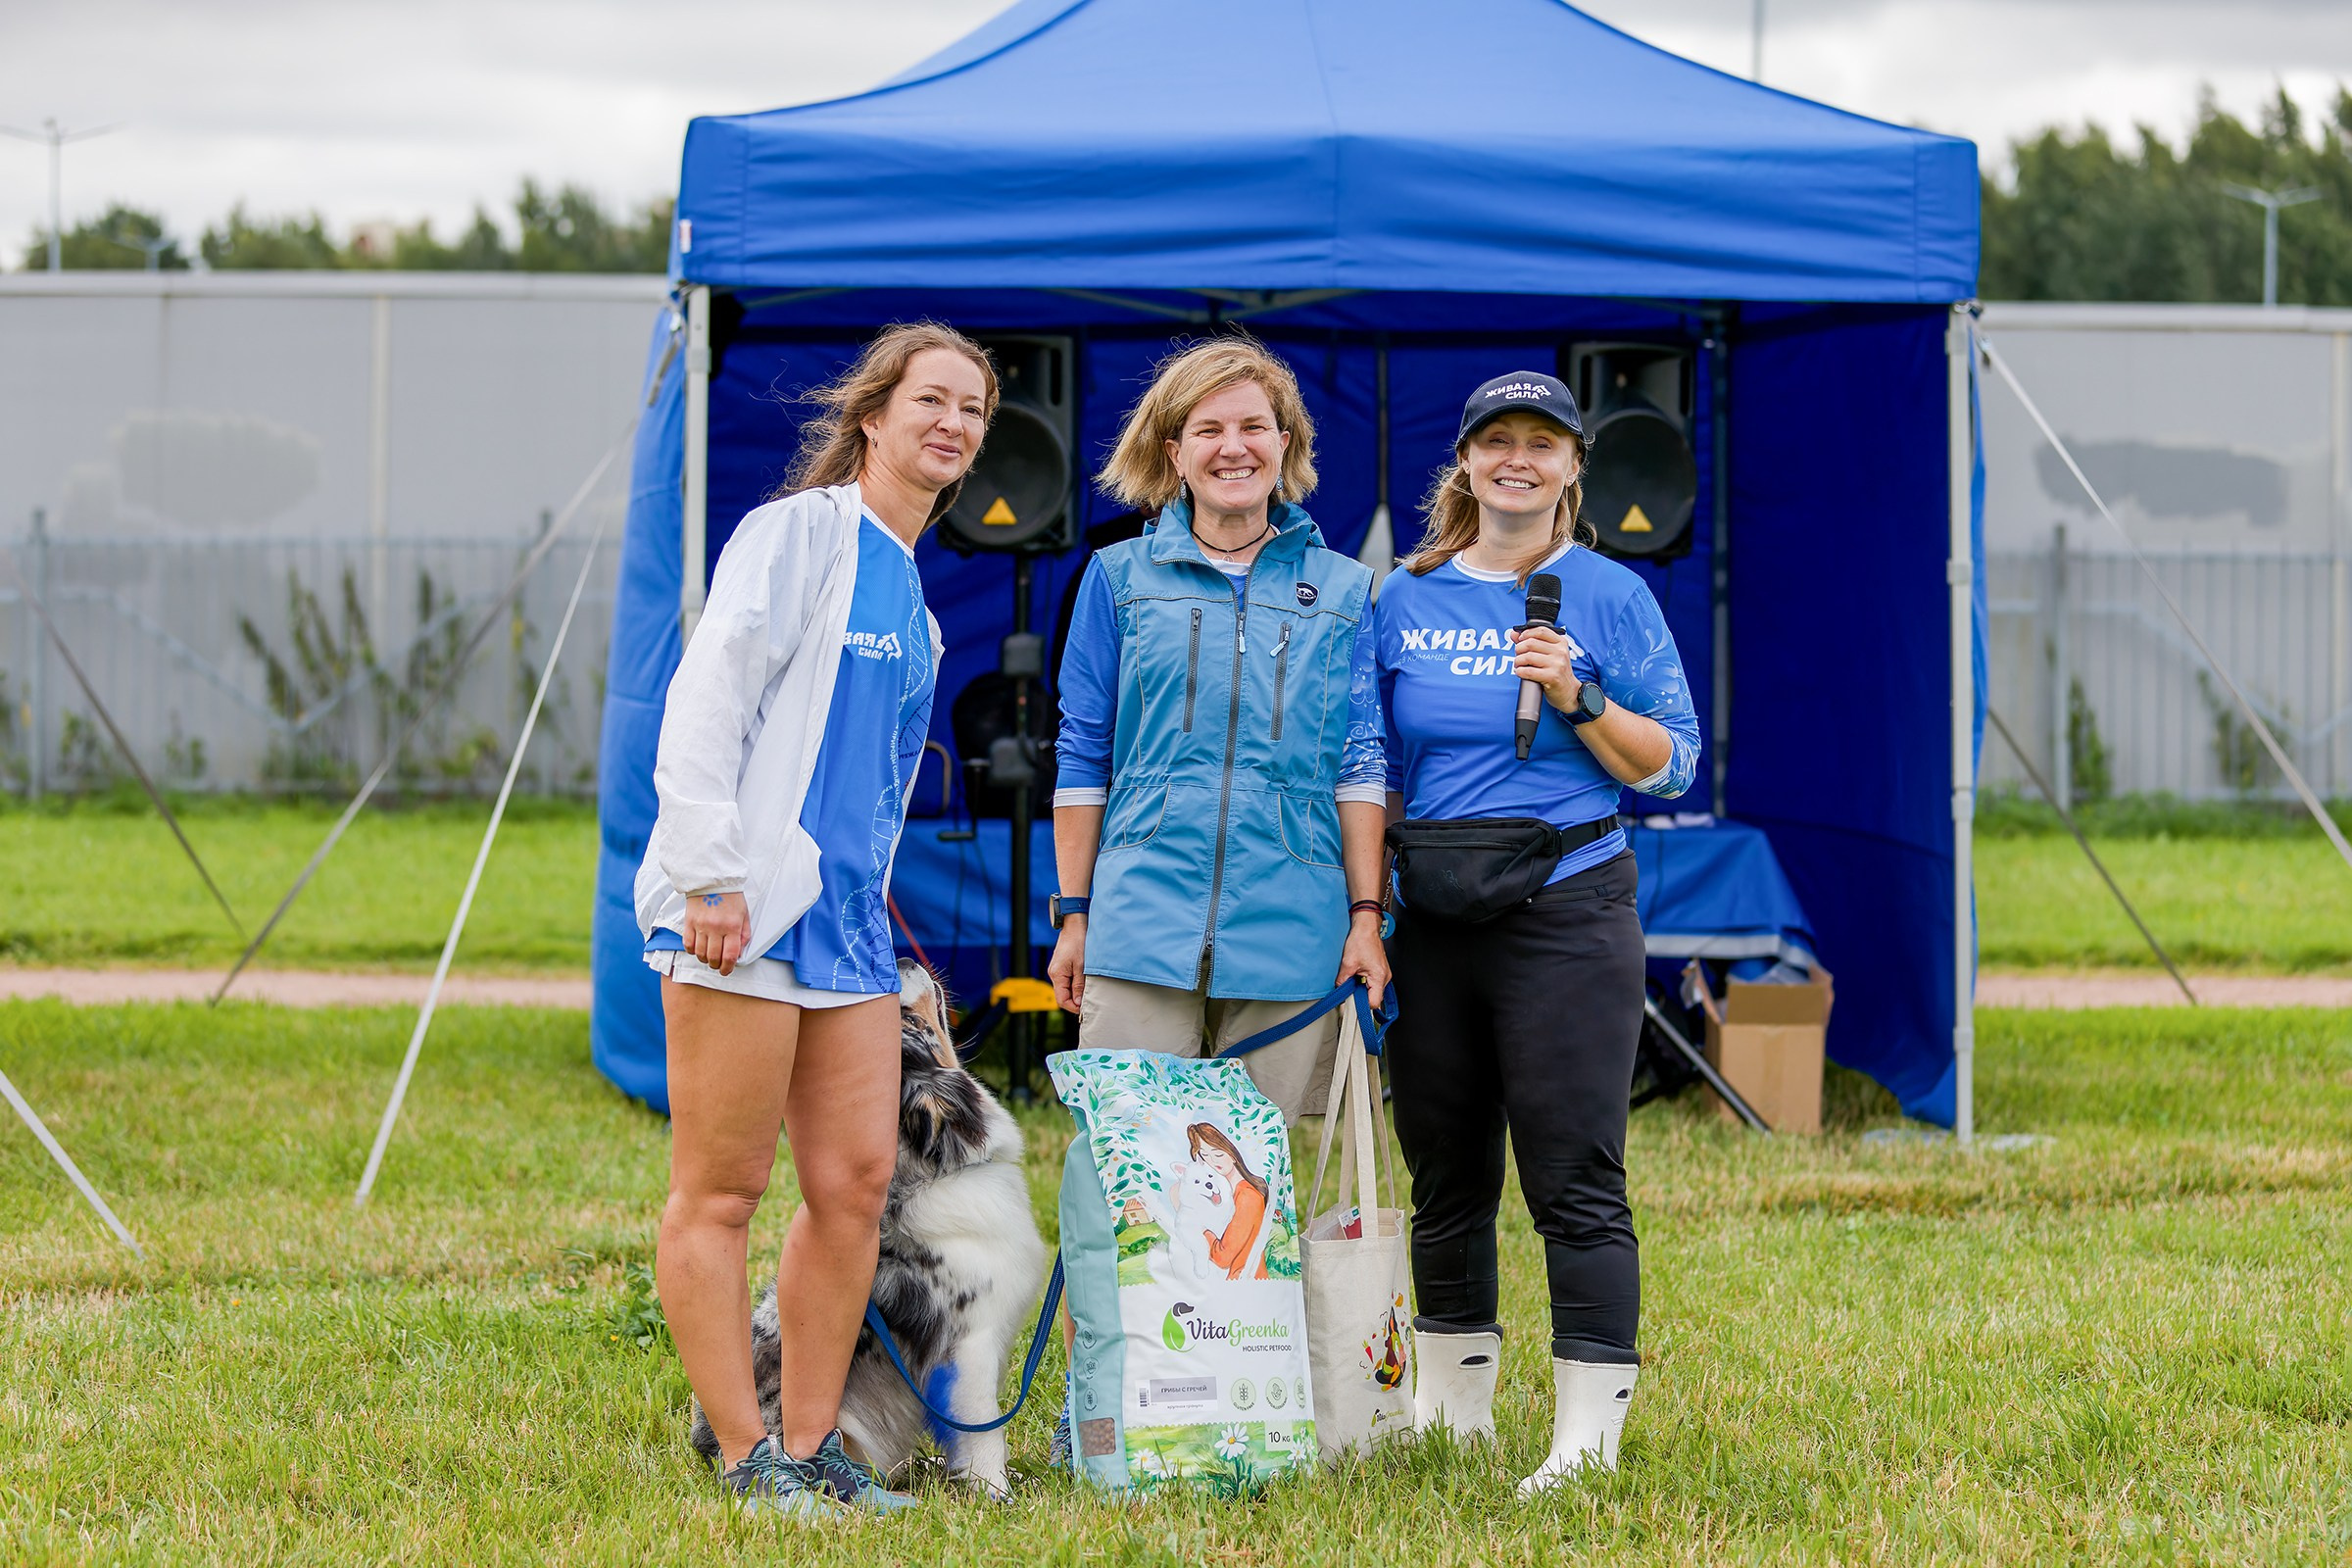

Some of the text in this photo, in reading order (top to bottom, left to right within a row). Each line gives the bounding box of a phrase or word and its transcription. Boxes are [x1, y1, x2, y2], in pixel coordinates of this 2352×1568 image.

[1485, 383, 1531, 398] ЖИВАЯ
[1505, 391, 1540, 400] СИЛА
[844, 631, 877, 647] ВАЯ
[1407, 653, 1450, 662] КОМАНДЕ
[1449, 656, 1516, 676] СИЛ
[1186, 1317, 1290, 1347] VitaGreenka
[1269, 1431, 1281, 1443] 10
